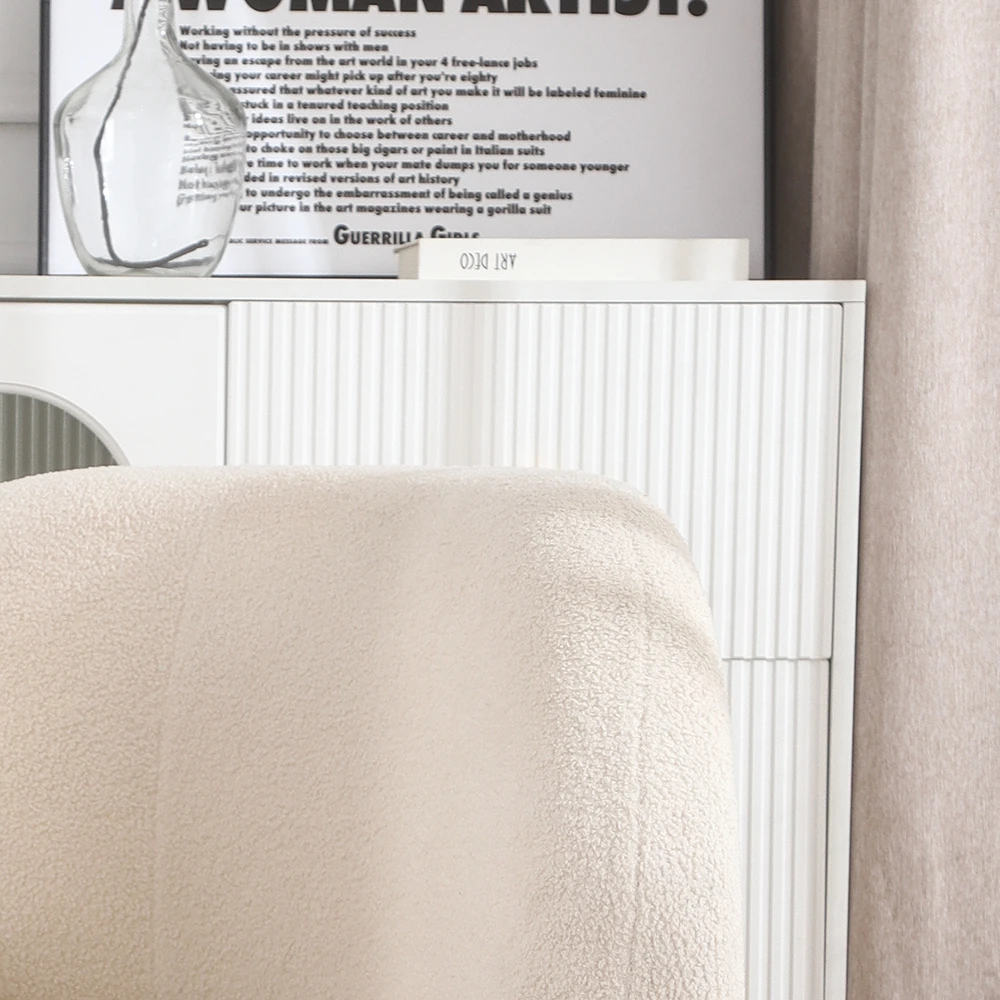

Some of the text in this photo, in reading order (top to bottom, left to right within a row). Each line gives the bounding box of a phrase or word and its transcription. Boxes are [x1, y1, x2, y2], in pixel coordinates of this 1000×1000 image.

[179, 24, 416, 39] Working without the pressure of success
[179, 39, 388, 53] Not having to be in shows with men
[195, 54, 538, 70] ving an escape from the art world in your 4 free-lance jobs
[234, 72, 261, 82] your
[264, 72, 302, 80] career
[304, 69, 339, 83] might
[342, 69, 366, 83] pick
[368, 73, 384, 83] up
[386, 69, 416, 81] after
[419, 71, 457, 83] you're
[459, 70, 497, 86] eighty
[279, 83, 303, 95] that
[306, 83, 363, 95] whatever
[365, 84, 392, 95] kind
[395, 84, 407, 95] of
[410, 86, 428, 96] art
[430, 88, 452, 98] you
[455, 85, 489, 96] make
[491, 85, 500, 96] it
[503, 85, 525, 97] will
[528, 86, 542, 97] be
[545, 86, 591, 98] labeled
[593, 86, 647, 98] feminine
[272, 98, 283, 109] in
[286, 101, 294, 109] a
[296, 98, 344, 110] tenured
[347, 98, 397, 113] teaching
[400, 99, 449, 113] position
[251, 113, 453, 125] ideas live on in the work of others
[245, 127, 571, 141] opportunity to choose between career and motherhood
[245, 142, 545, 157] to choke on those big cigars or paint in Italian suits
[256, 156, 283, 167] time
[287, 158, 299, 168] to
[301, 157, 332, 168] work
[335, 157, 368, 168] when
[370, 161, 398, 171] your
[401, 159, 432, 169] mate
[434, 158, 475, 172] dumps
[477, 162, 499, 172] you
[502, 158, 520, 170] for
[522, 162, 577, 171] someone
[579, 163, 629, 174] younger
[268, 171, 279, 182] in
[282, 171, 327, 183] revised
[329, 172, 380, 183] versions
[382, 172, 395, 183] of
[397, 174, 415, 183] art
[418, 172, 460, 187] history
[245, 186, 573, 203] to undergo the embarrassment of being called a genius
[255, 201, 295, 215] picture
[299, 201, 310, 212] in
[313, 201, 332, 212] the
[335, 203, 353, 212] art
[355, 202, 421, 216] magazines
[424, 202, 473, 217] wearing
[476, 206, 484, 214] a
[486, 203, 526, 217] gorilla
[529, 203, 551, 214] suit
[460, 252, 517, 270] ART DECO
